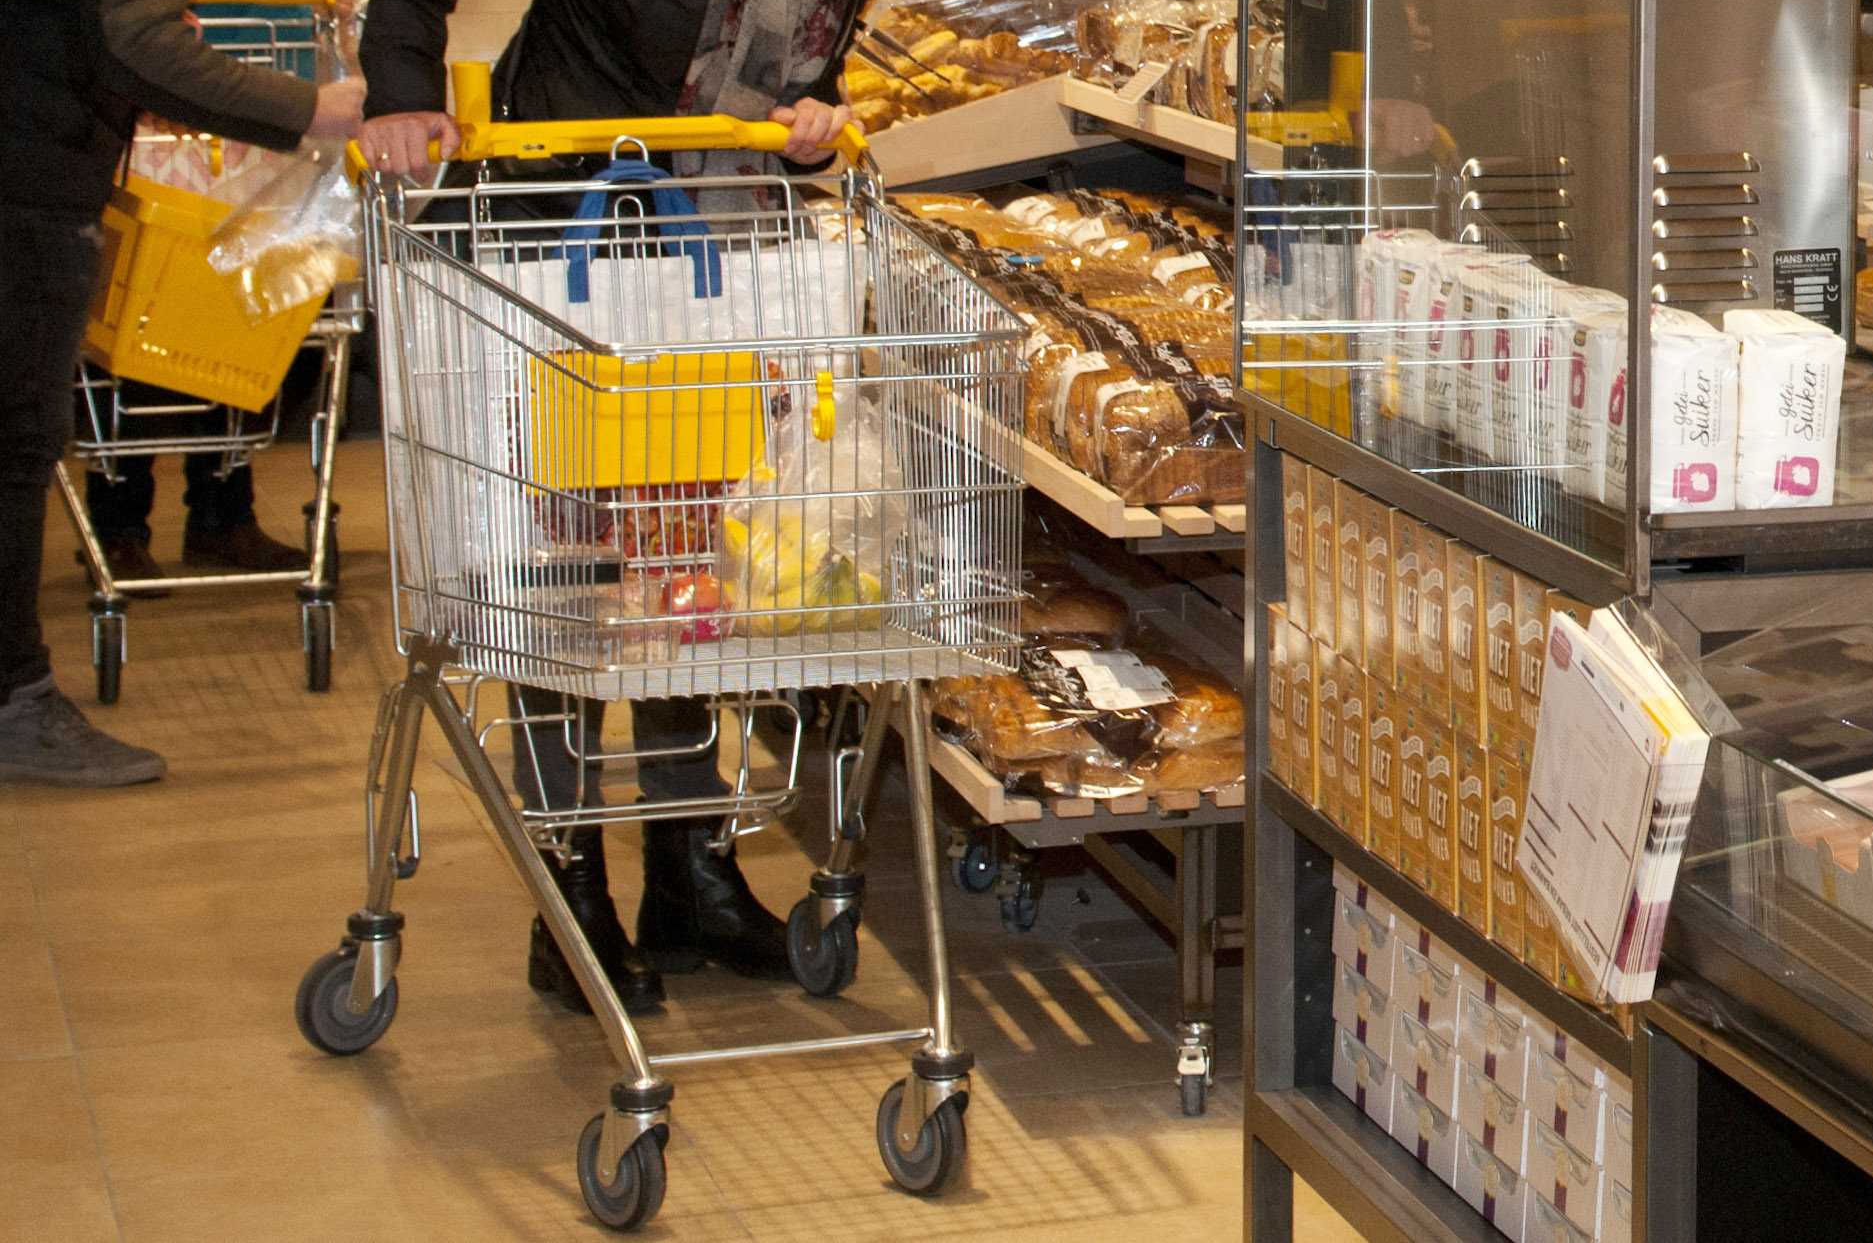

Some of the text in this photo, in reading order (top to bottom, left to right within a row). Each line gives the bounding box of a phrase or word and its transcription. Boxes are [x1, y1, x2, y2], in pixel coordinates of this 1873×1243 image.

[1775, 252, 1838, 264] HANS KRATT
[1690, 369, 1711, 447] Suiker
[1793, 362, 1819, 441] Suiker
